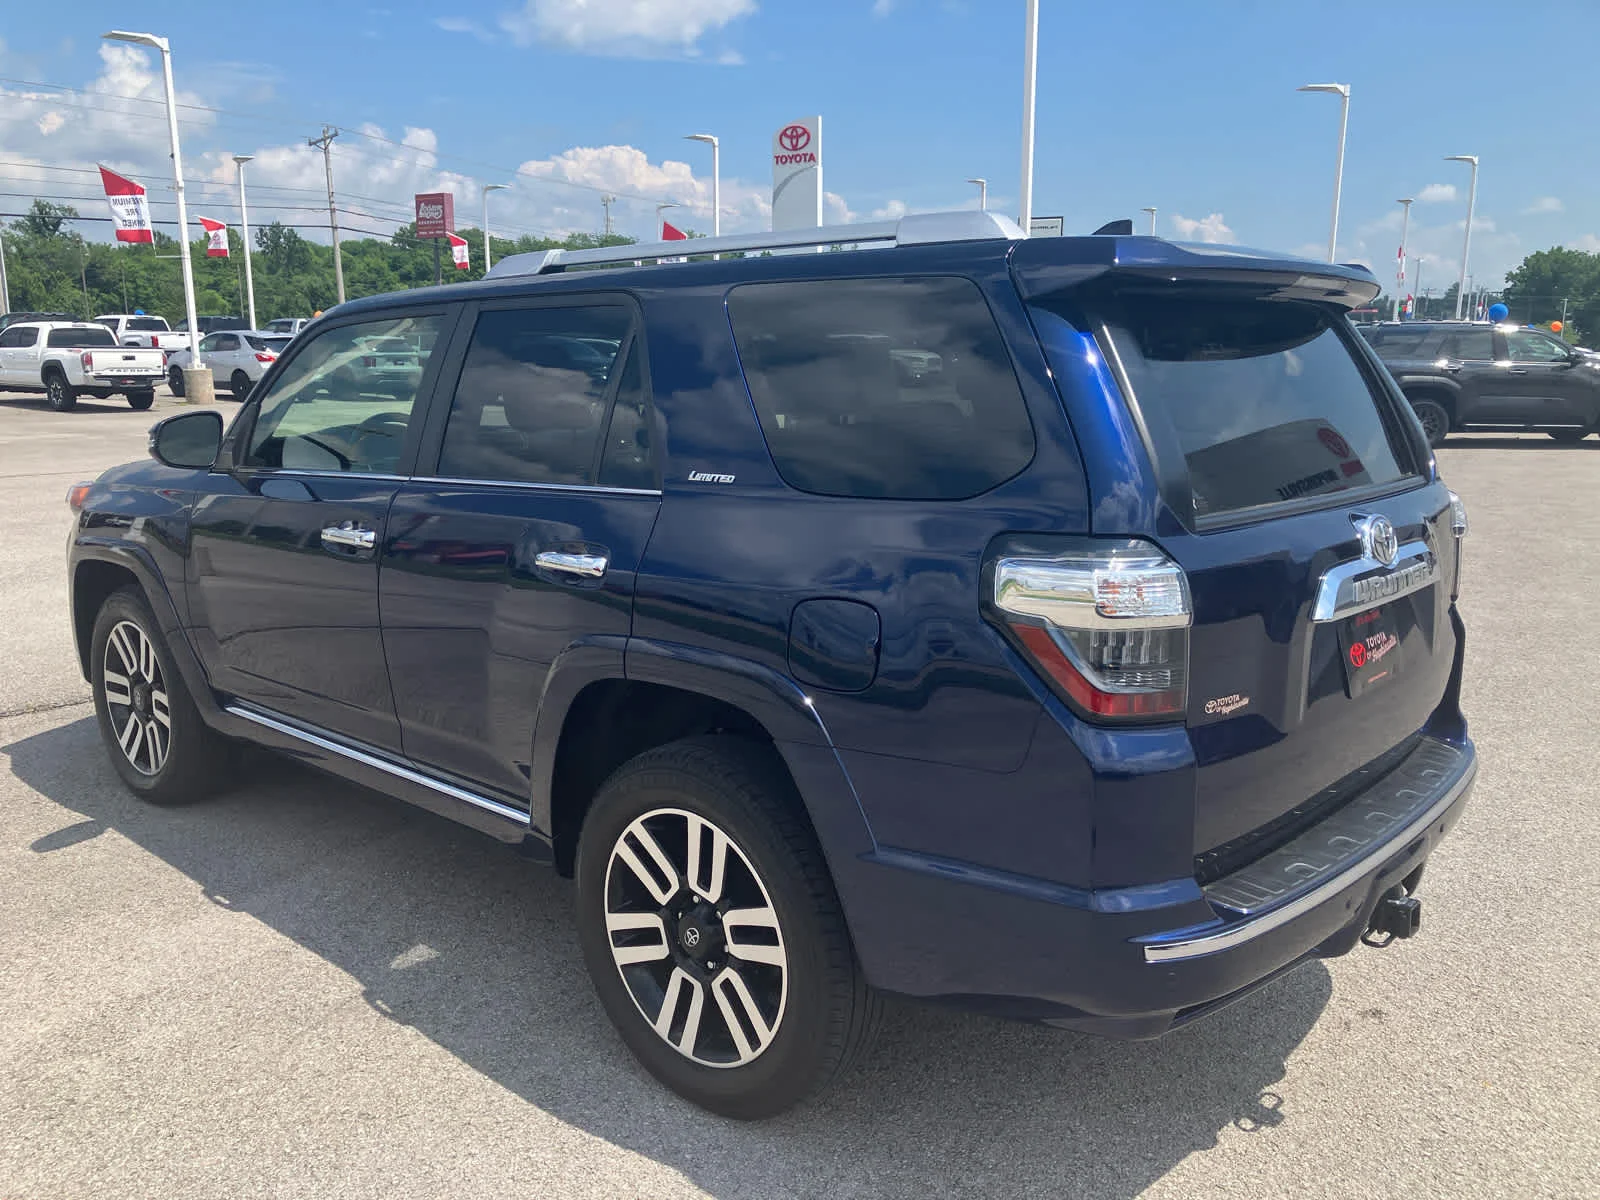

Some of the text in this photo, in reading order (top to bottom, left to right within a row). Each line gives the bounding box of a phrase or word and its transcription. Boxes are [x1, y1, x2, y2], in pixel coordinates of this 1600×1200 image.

[774, 152, 817, 165] TOYOTA
[1366, 631, 1388, 649] TOYOTA
[1216, 694, 1241, 706] TOYOTA
